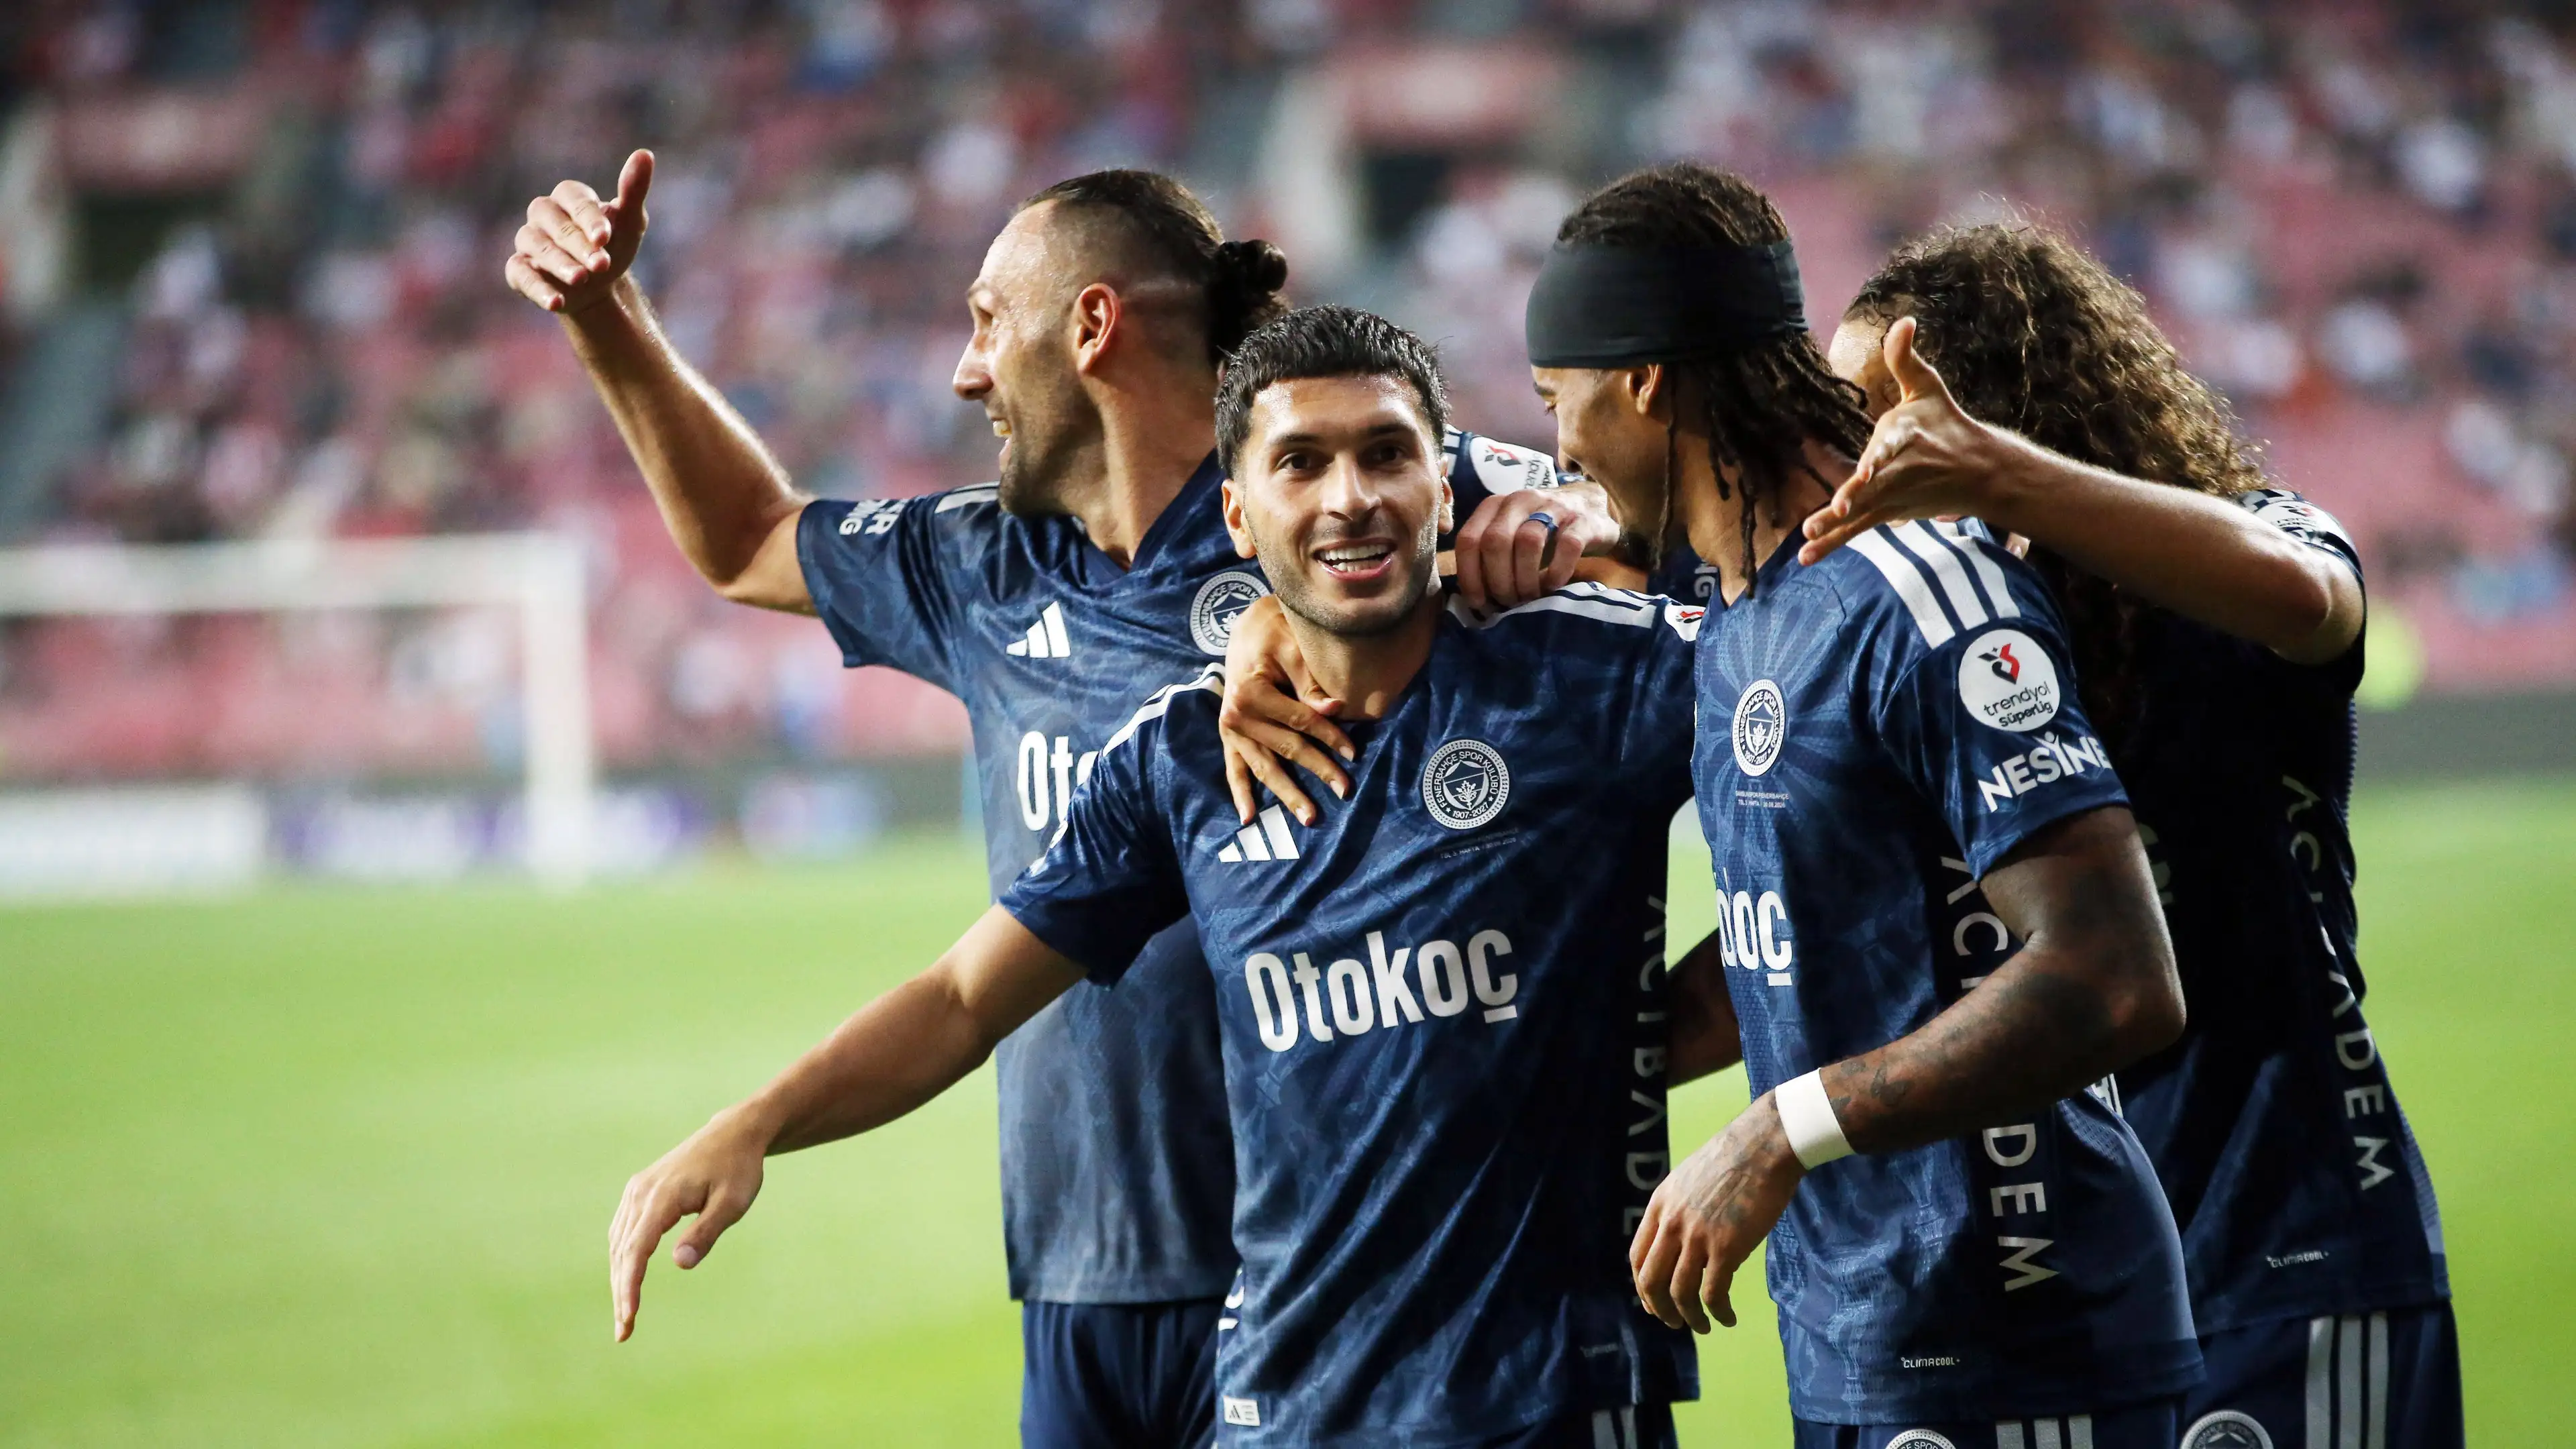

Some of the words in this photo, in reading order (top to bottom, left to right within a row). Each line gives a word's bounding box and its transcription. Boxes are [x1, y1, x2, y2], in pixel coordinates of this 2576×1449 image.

[1764, 692, 1777, 709] SPOR
[1984, 681, 2051, 716] trendyol
[1434, 753, 1458, 808] FENERBAHÇE
[1458, 751, 1484, 763] SPOR
[1483, 759, 1499, 795] KULÜBÜ
[1452, 802, 1489, 819] 1907-2027
[1244, 929, 1518, 1053] Otokoç
